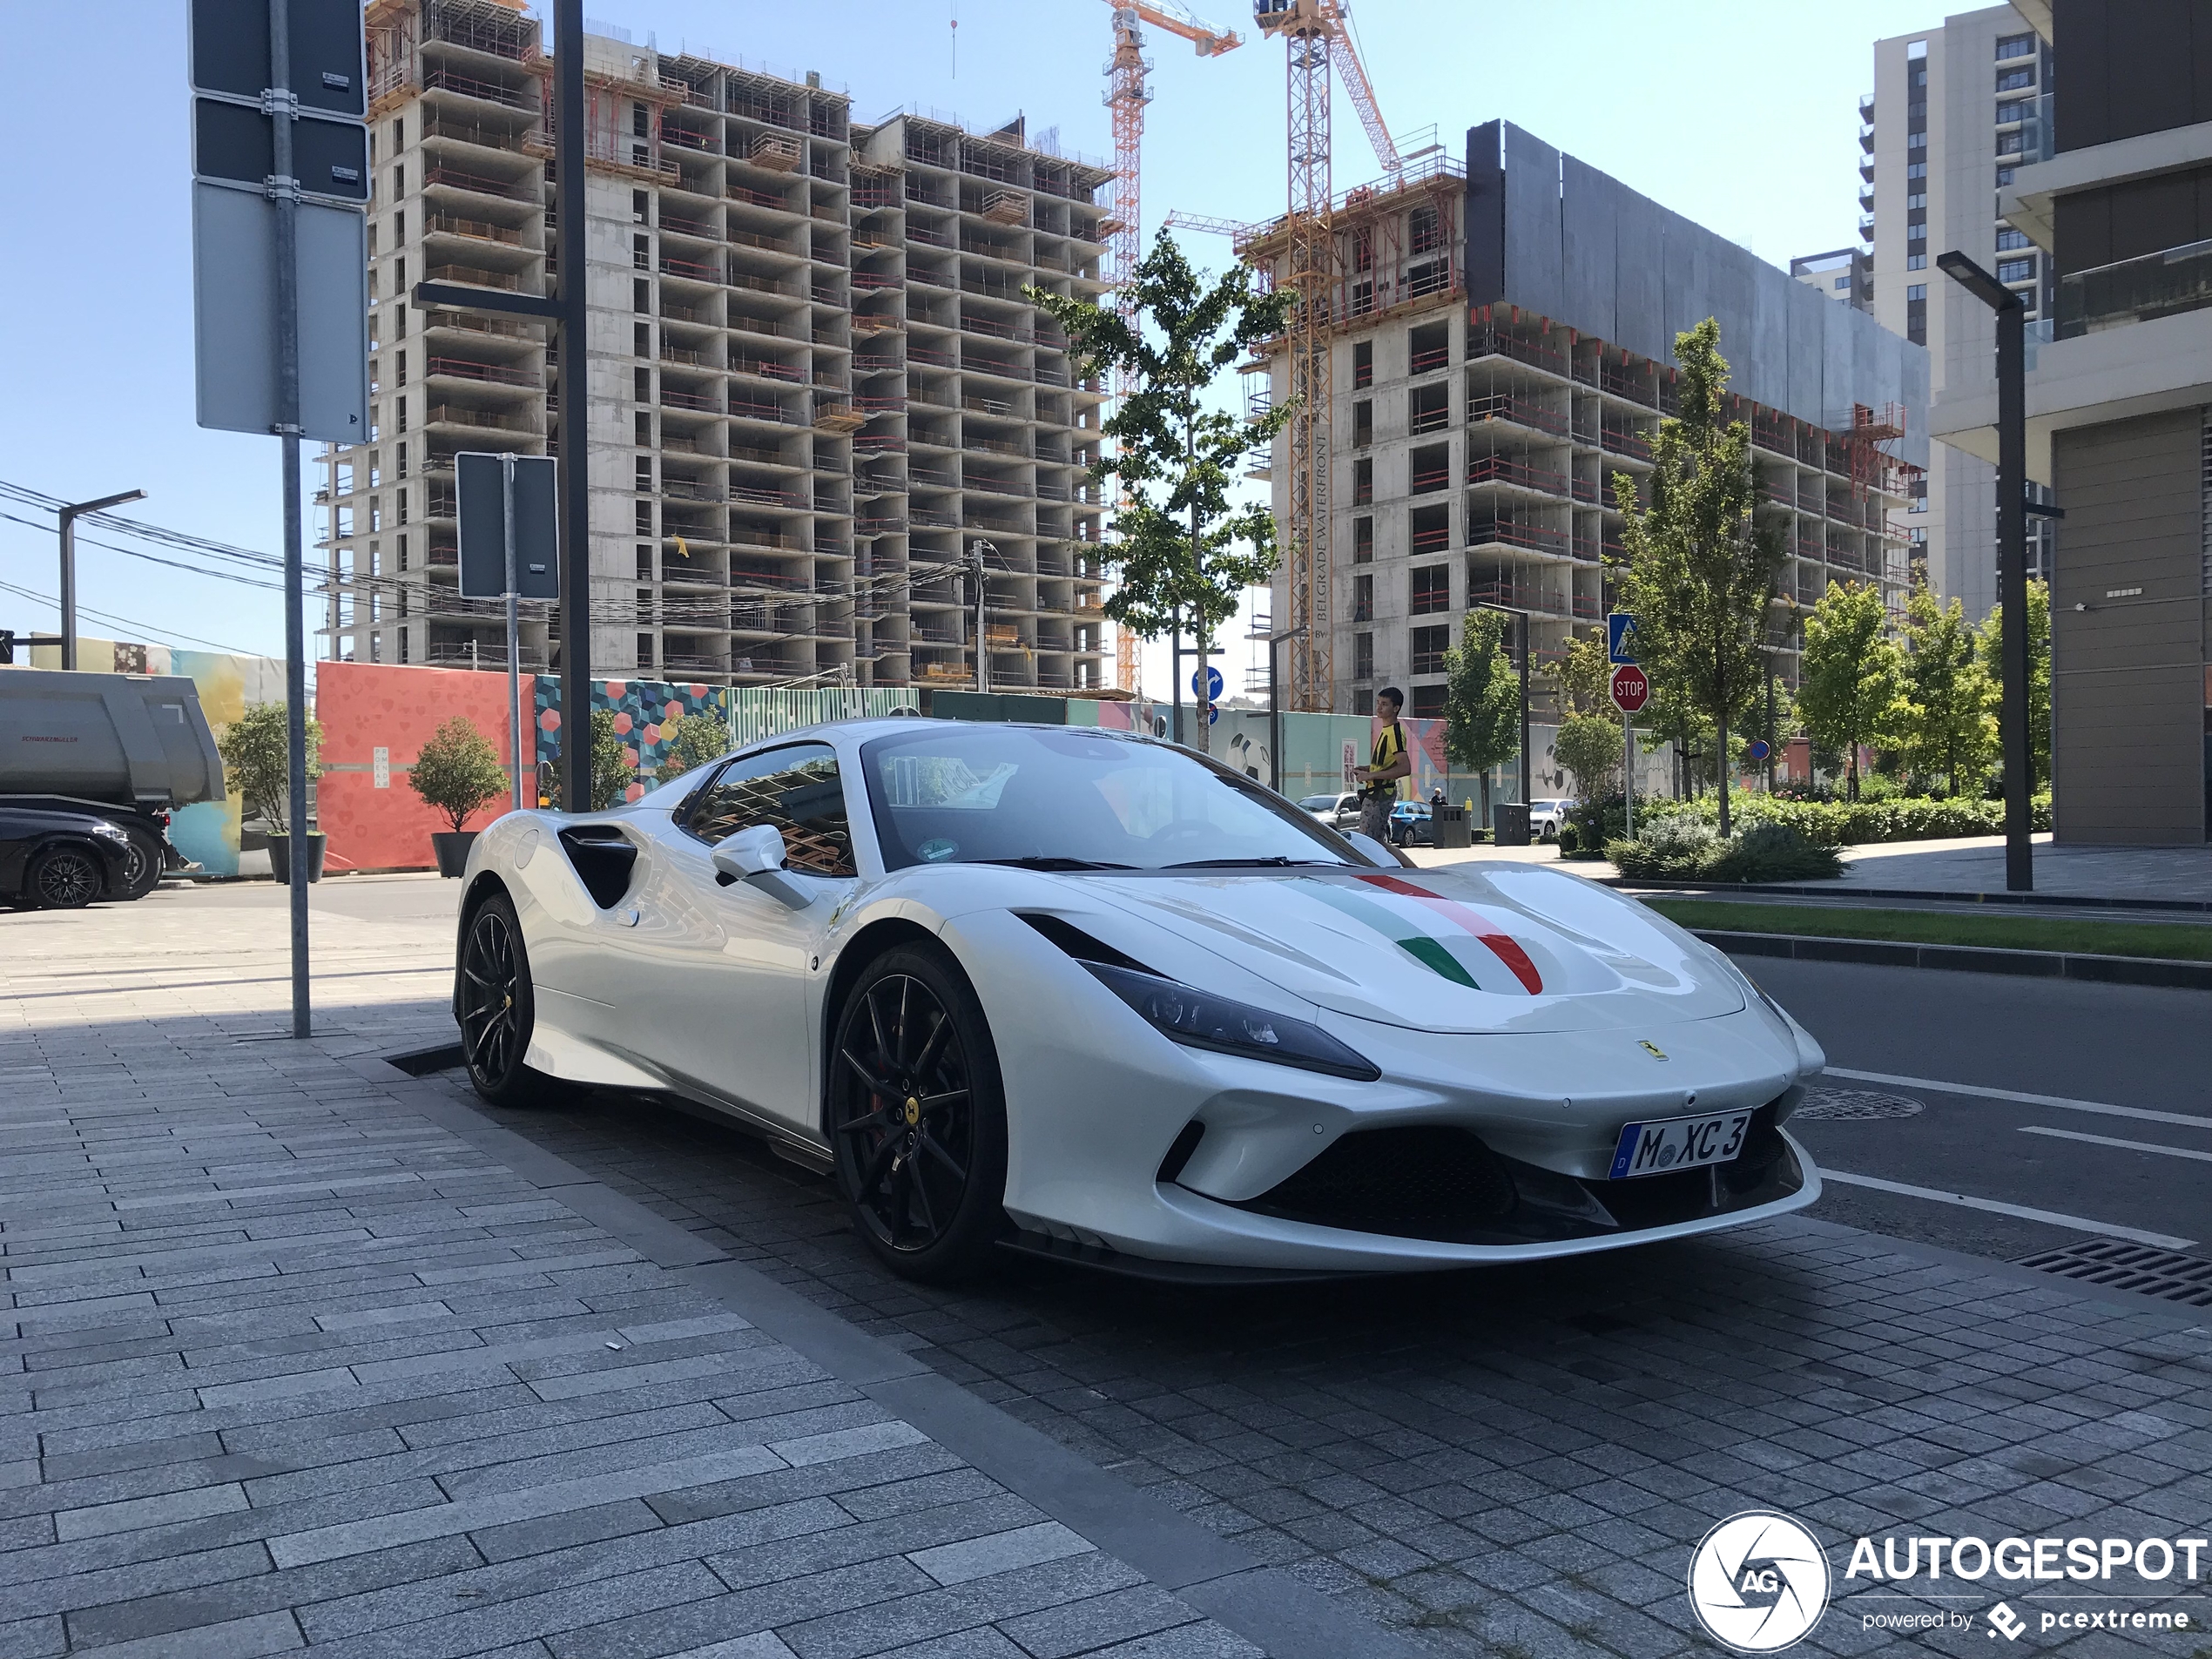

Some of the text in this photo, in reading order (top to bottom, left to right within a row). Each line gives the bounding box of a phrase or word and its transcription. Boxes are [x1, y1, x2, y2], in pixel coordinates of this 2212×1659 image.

[1316, 433, 1327, 621] BELGRADE WATERFRONT
[1315, 630, 1328, 638] BW
[1616, 681, 1644, 697] STOP
[1635, 1116, 1748, 1170] M XC 3
[1617, 1157, 1626, 1169] D
